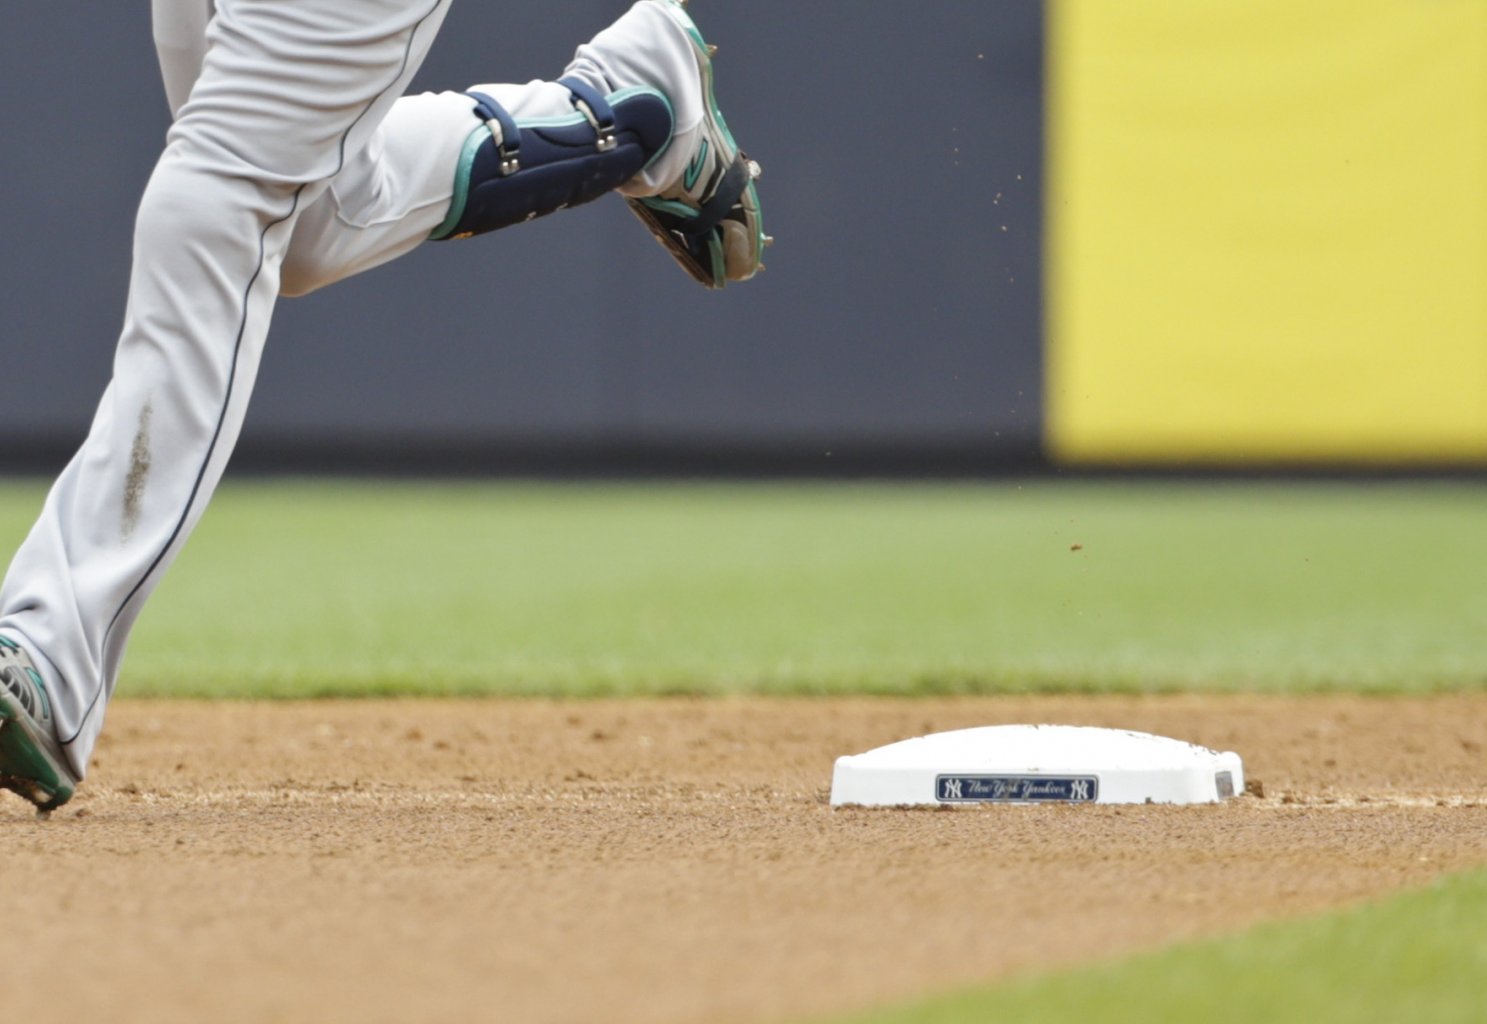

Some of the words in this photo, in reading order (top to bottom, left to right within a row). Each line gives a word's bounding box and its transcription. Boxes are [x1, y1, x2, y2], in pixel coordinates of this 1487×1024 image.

[967, 780, 993, 793] New
[992, 780, 1019, 799] York
[1021, 780, 1065, 800] Yankees
